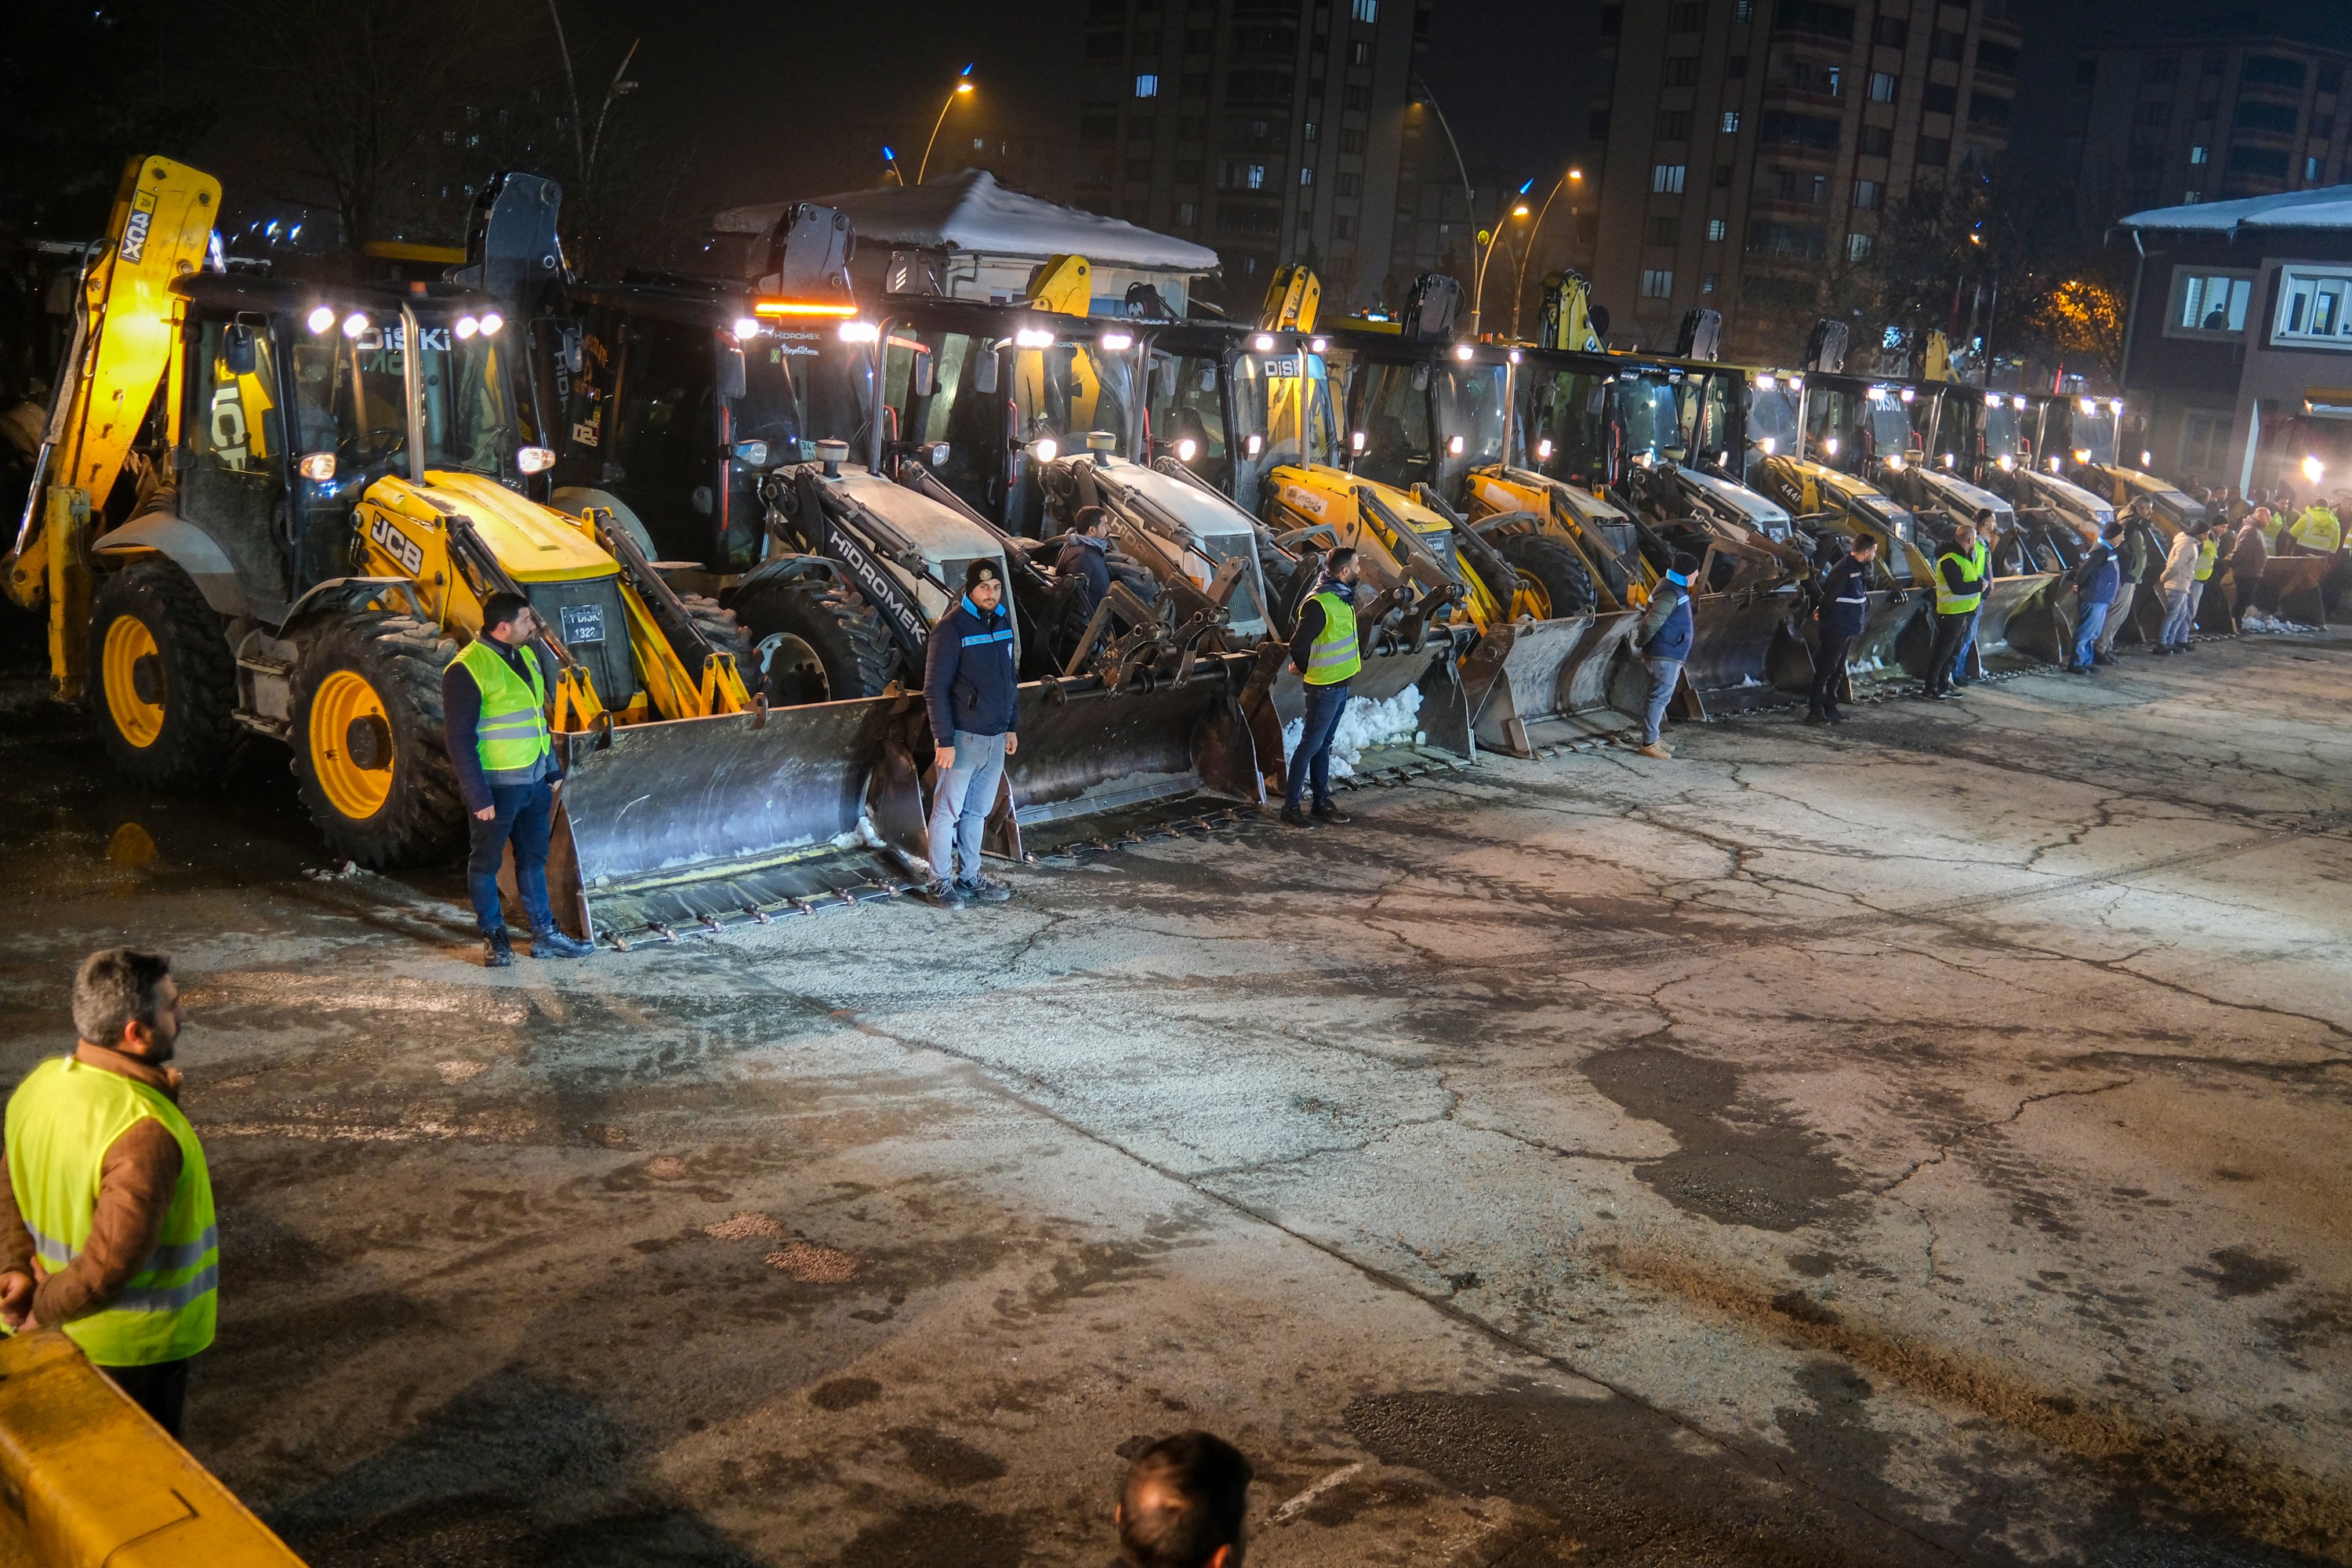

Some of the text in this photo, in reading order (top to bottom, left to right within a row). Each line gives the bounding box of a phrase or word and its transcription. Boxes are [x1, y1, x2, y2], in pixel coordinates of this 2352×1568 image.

[122, 213, 149, 259] 4CX
[372, 514, 422, 574] JCB
[829, 531, 927, 646] HiDROMEK
